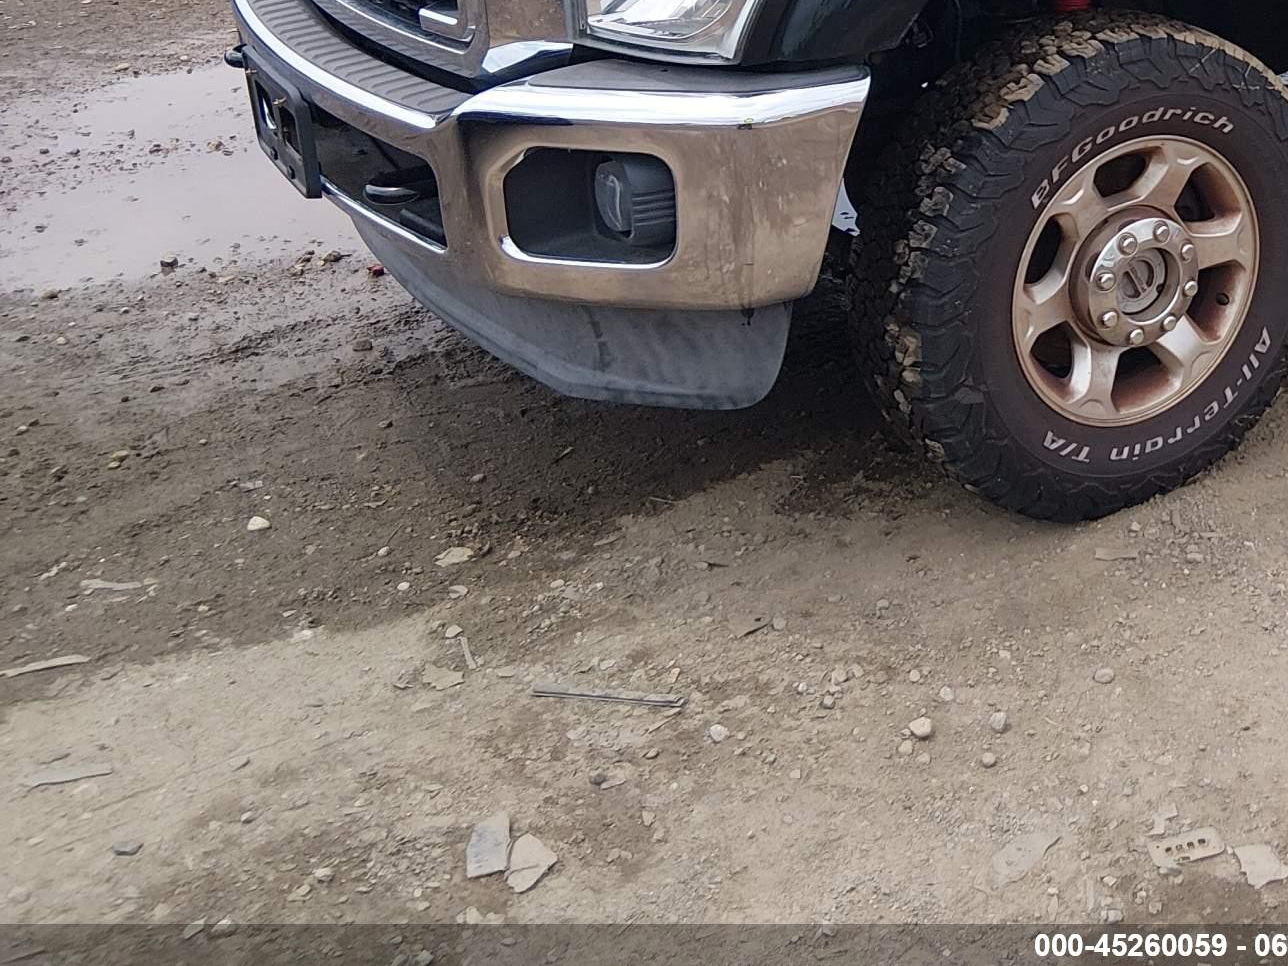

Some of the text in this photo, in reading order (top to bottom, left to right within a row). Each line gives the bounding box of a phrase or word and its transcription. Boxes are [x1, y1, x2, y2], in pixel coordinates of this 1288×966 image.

[1031, 106, 1235, 209] BFGoodrich
[1042, 326, 1272, 463] All-Terrain T/A
